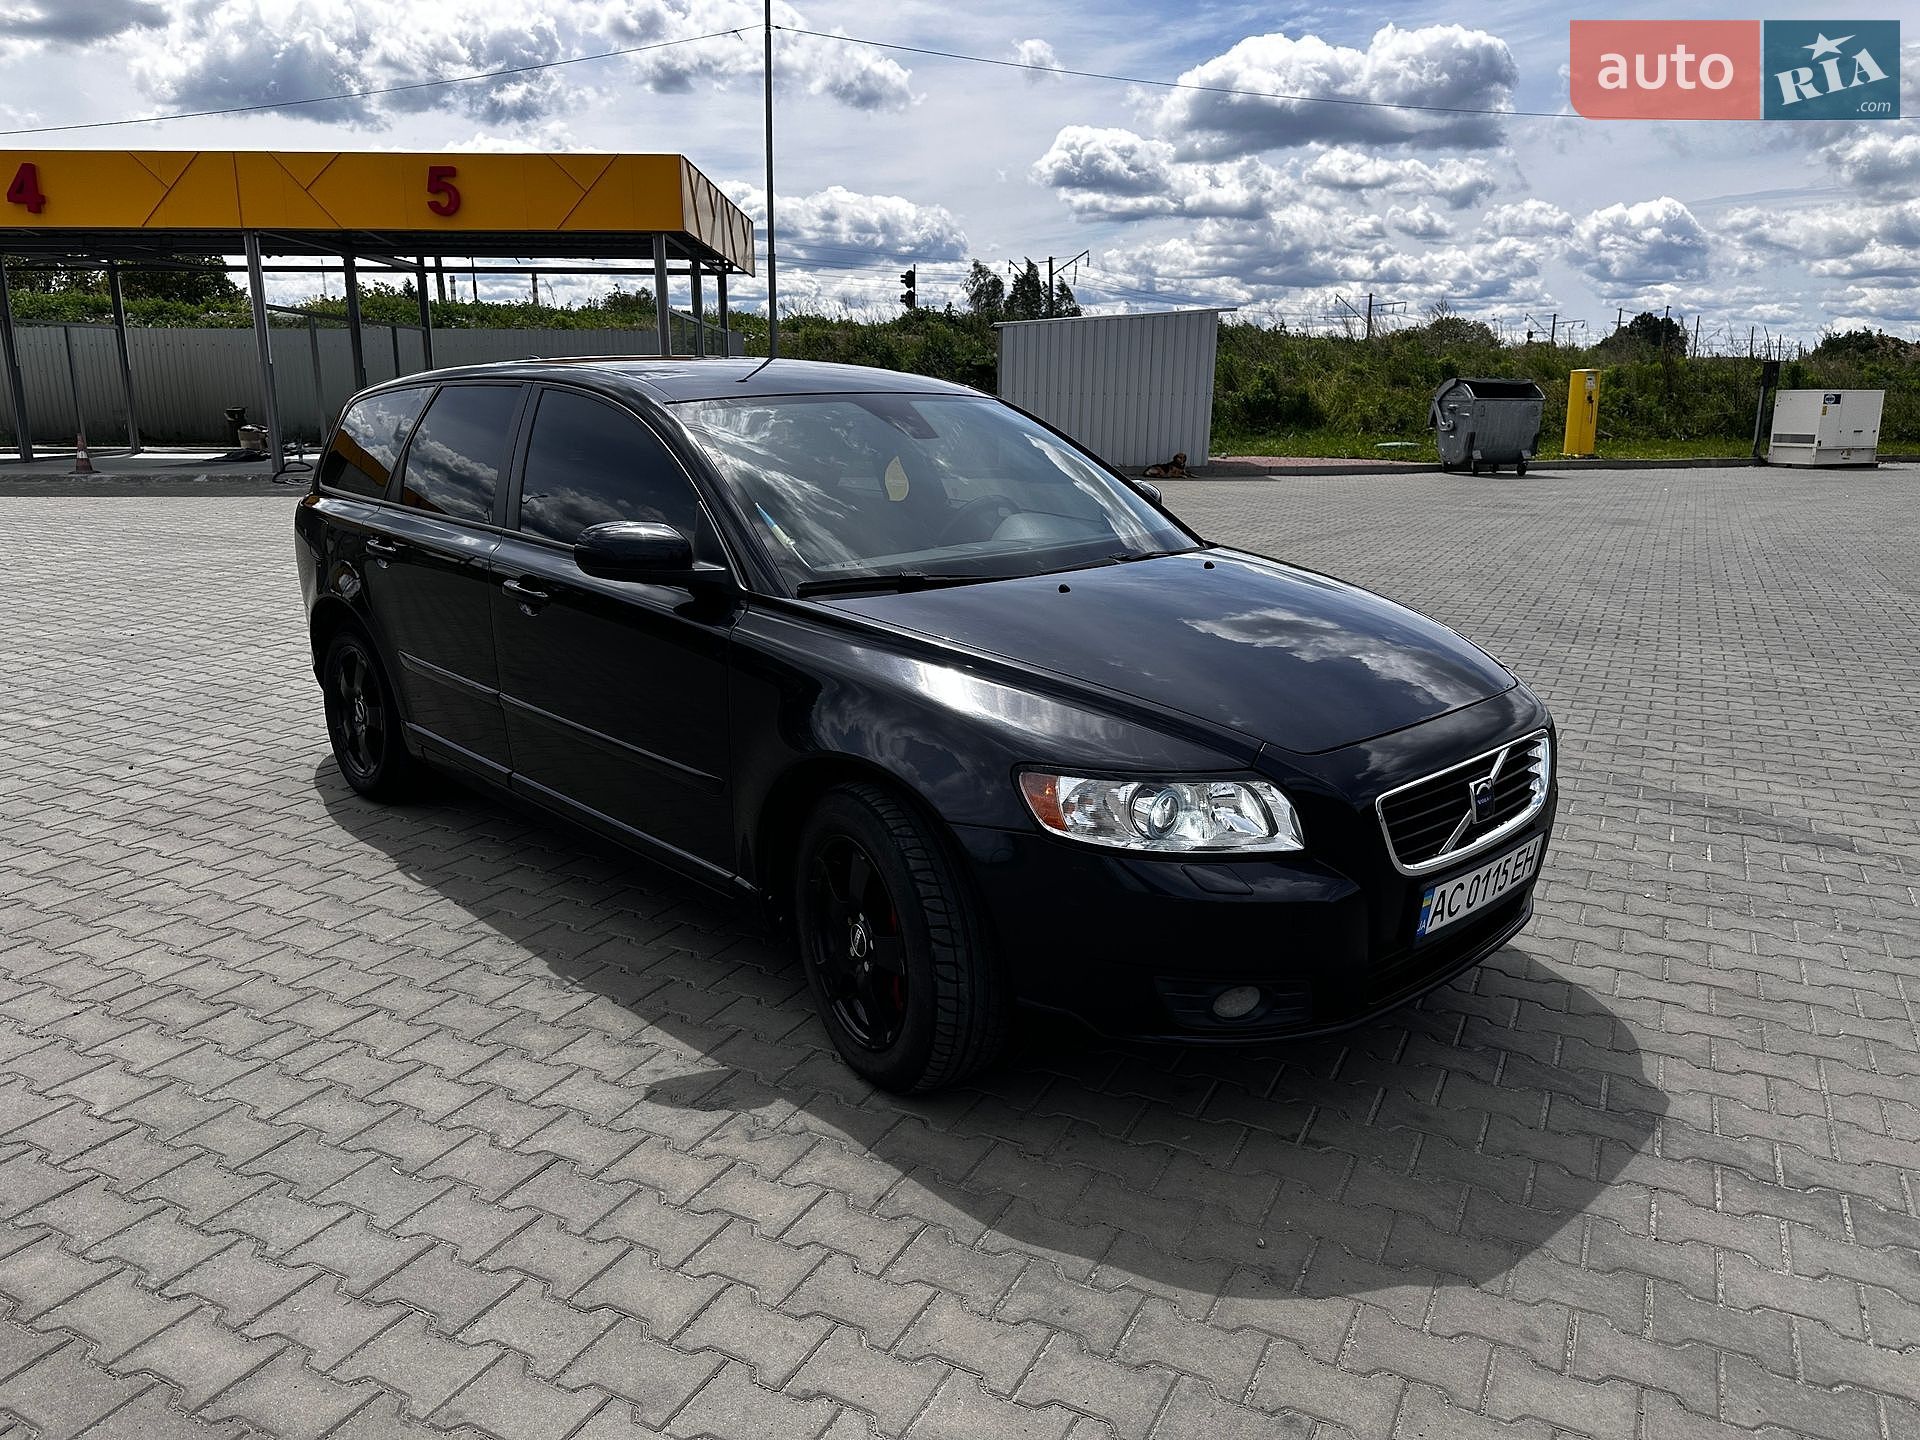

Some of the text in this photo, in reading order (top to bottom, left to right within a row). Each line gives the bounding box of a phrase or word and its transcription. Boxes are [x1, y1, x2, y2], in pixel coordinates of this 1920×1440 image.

[6, 162, 46, 214] 4
[426, 165, 461, 217] 5
[1428, 841, 1539, 928] AC 0115 EH
